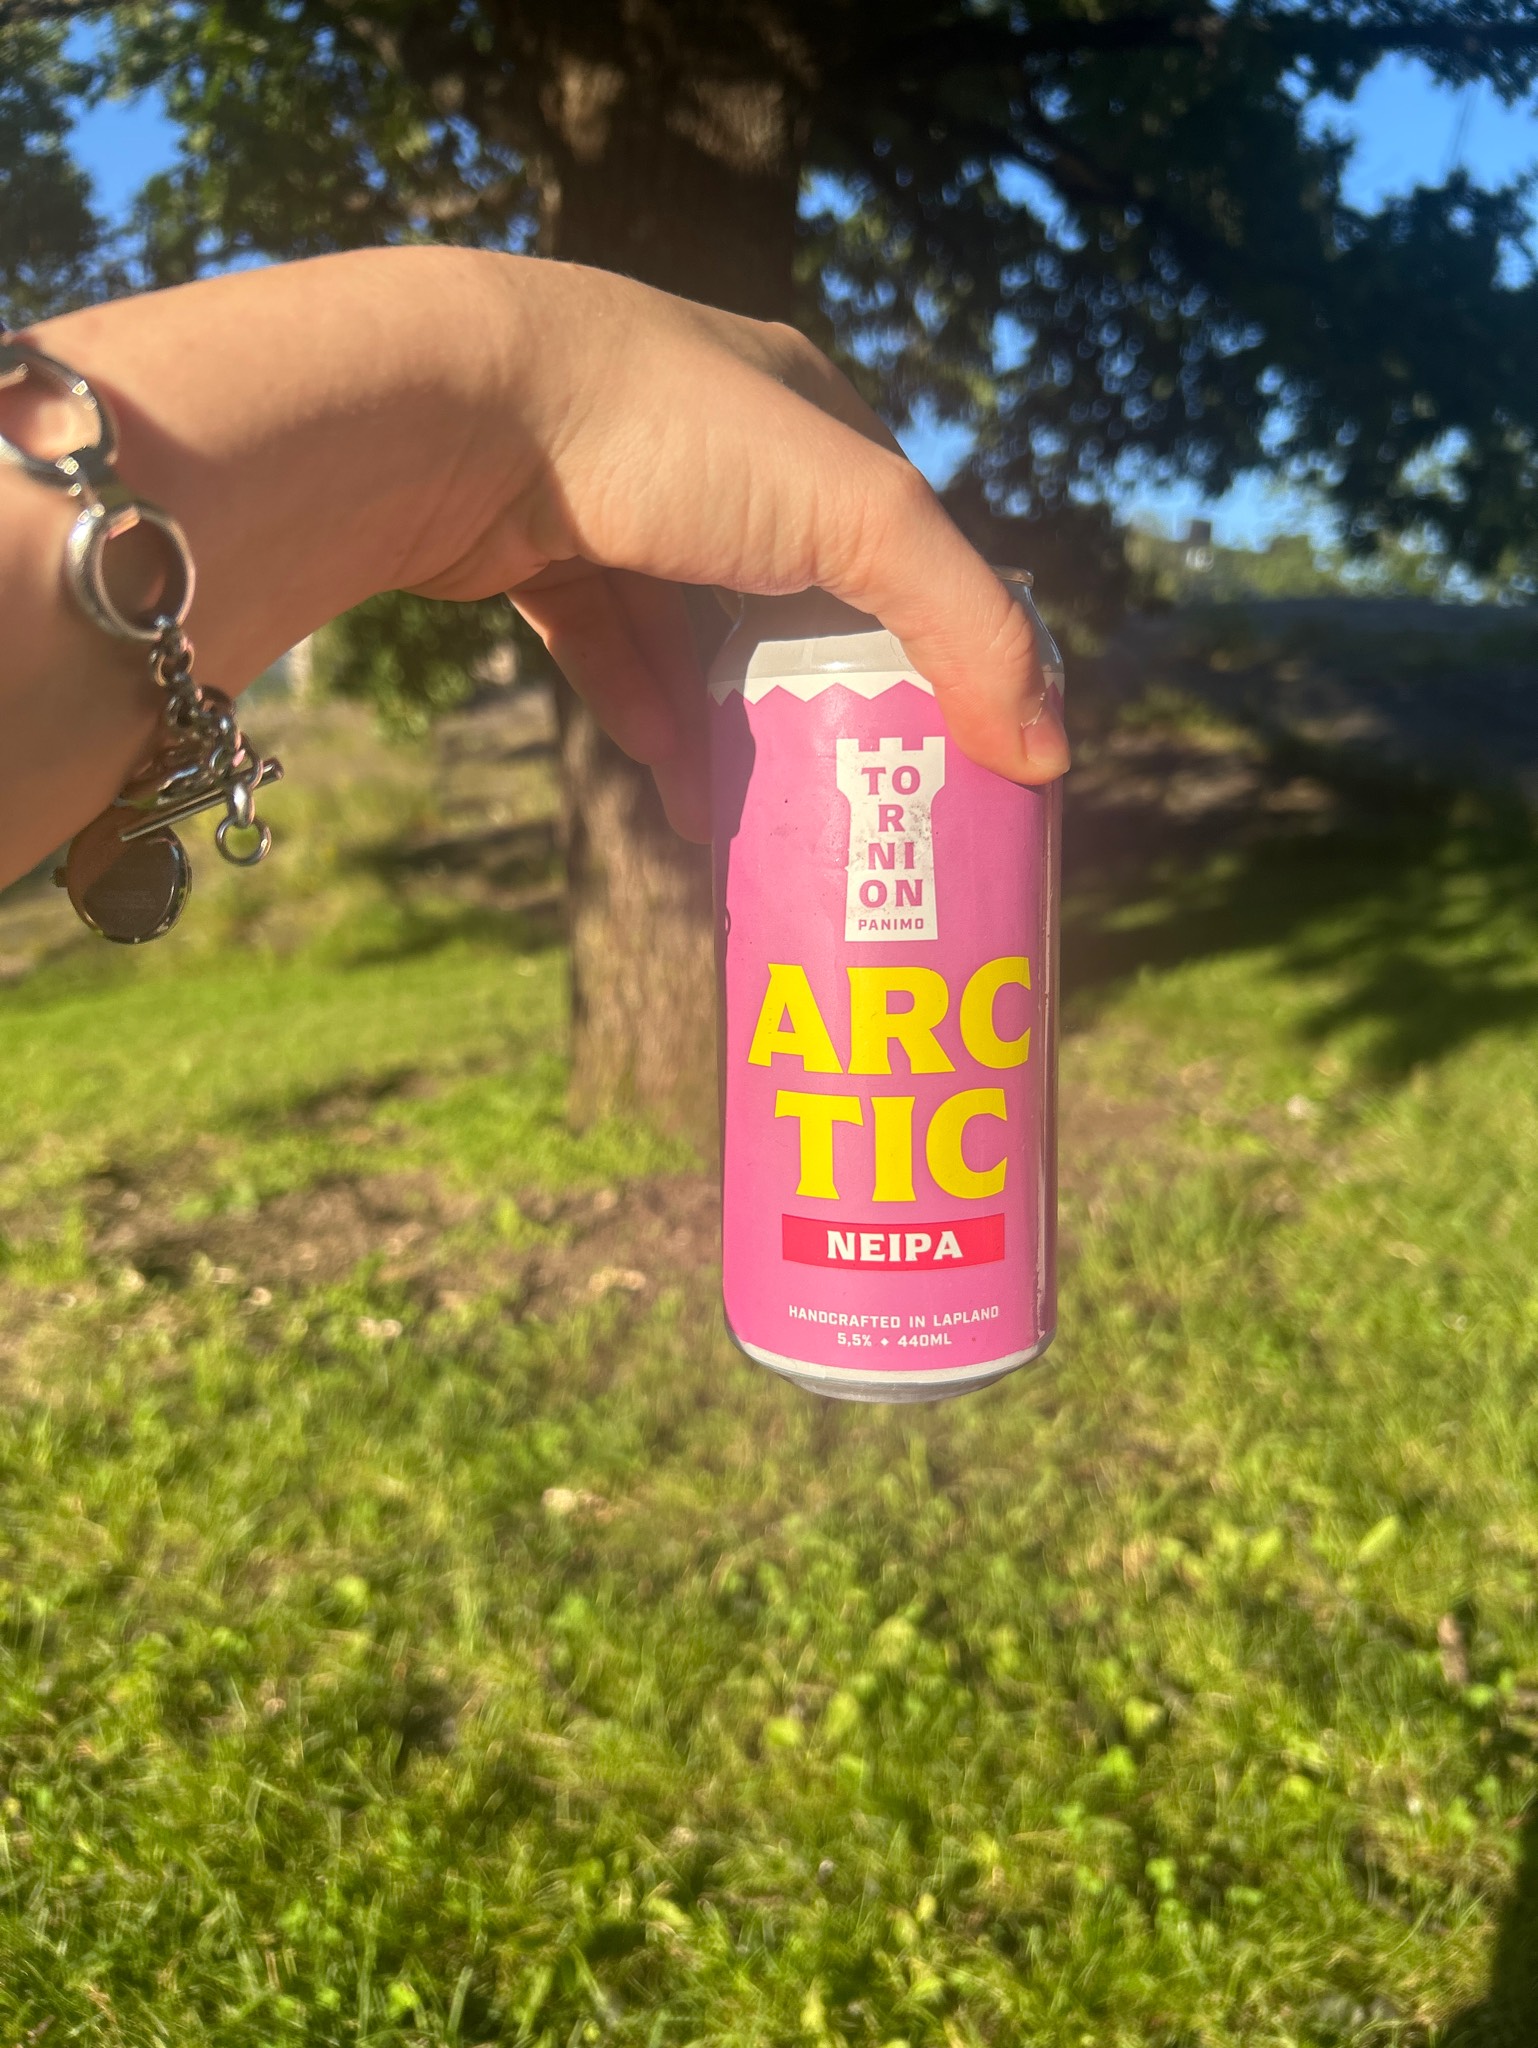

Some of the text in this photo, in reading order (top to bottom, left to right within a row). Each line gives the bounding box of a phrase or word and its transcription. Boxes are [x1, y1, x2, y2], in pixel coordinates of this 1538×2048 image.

[861, 765, 921, 796] TO
[878, 804, 906, 832] R
[868, 842, 915, 870] NI
[858, 879, 924, 908] ON
[858, 918, 924, 931] PANIMO
[747, 956, 1031, 1075] ARC
[774, 1087, 1008, 1202] TIC
[826, 1230, 963, 1262] NEIPA
[788, 1304, 999, 1329] HANDCRAFTED IN LAPLAND
[837, 1332, 952, 1347] 5,5% 440ML
